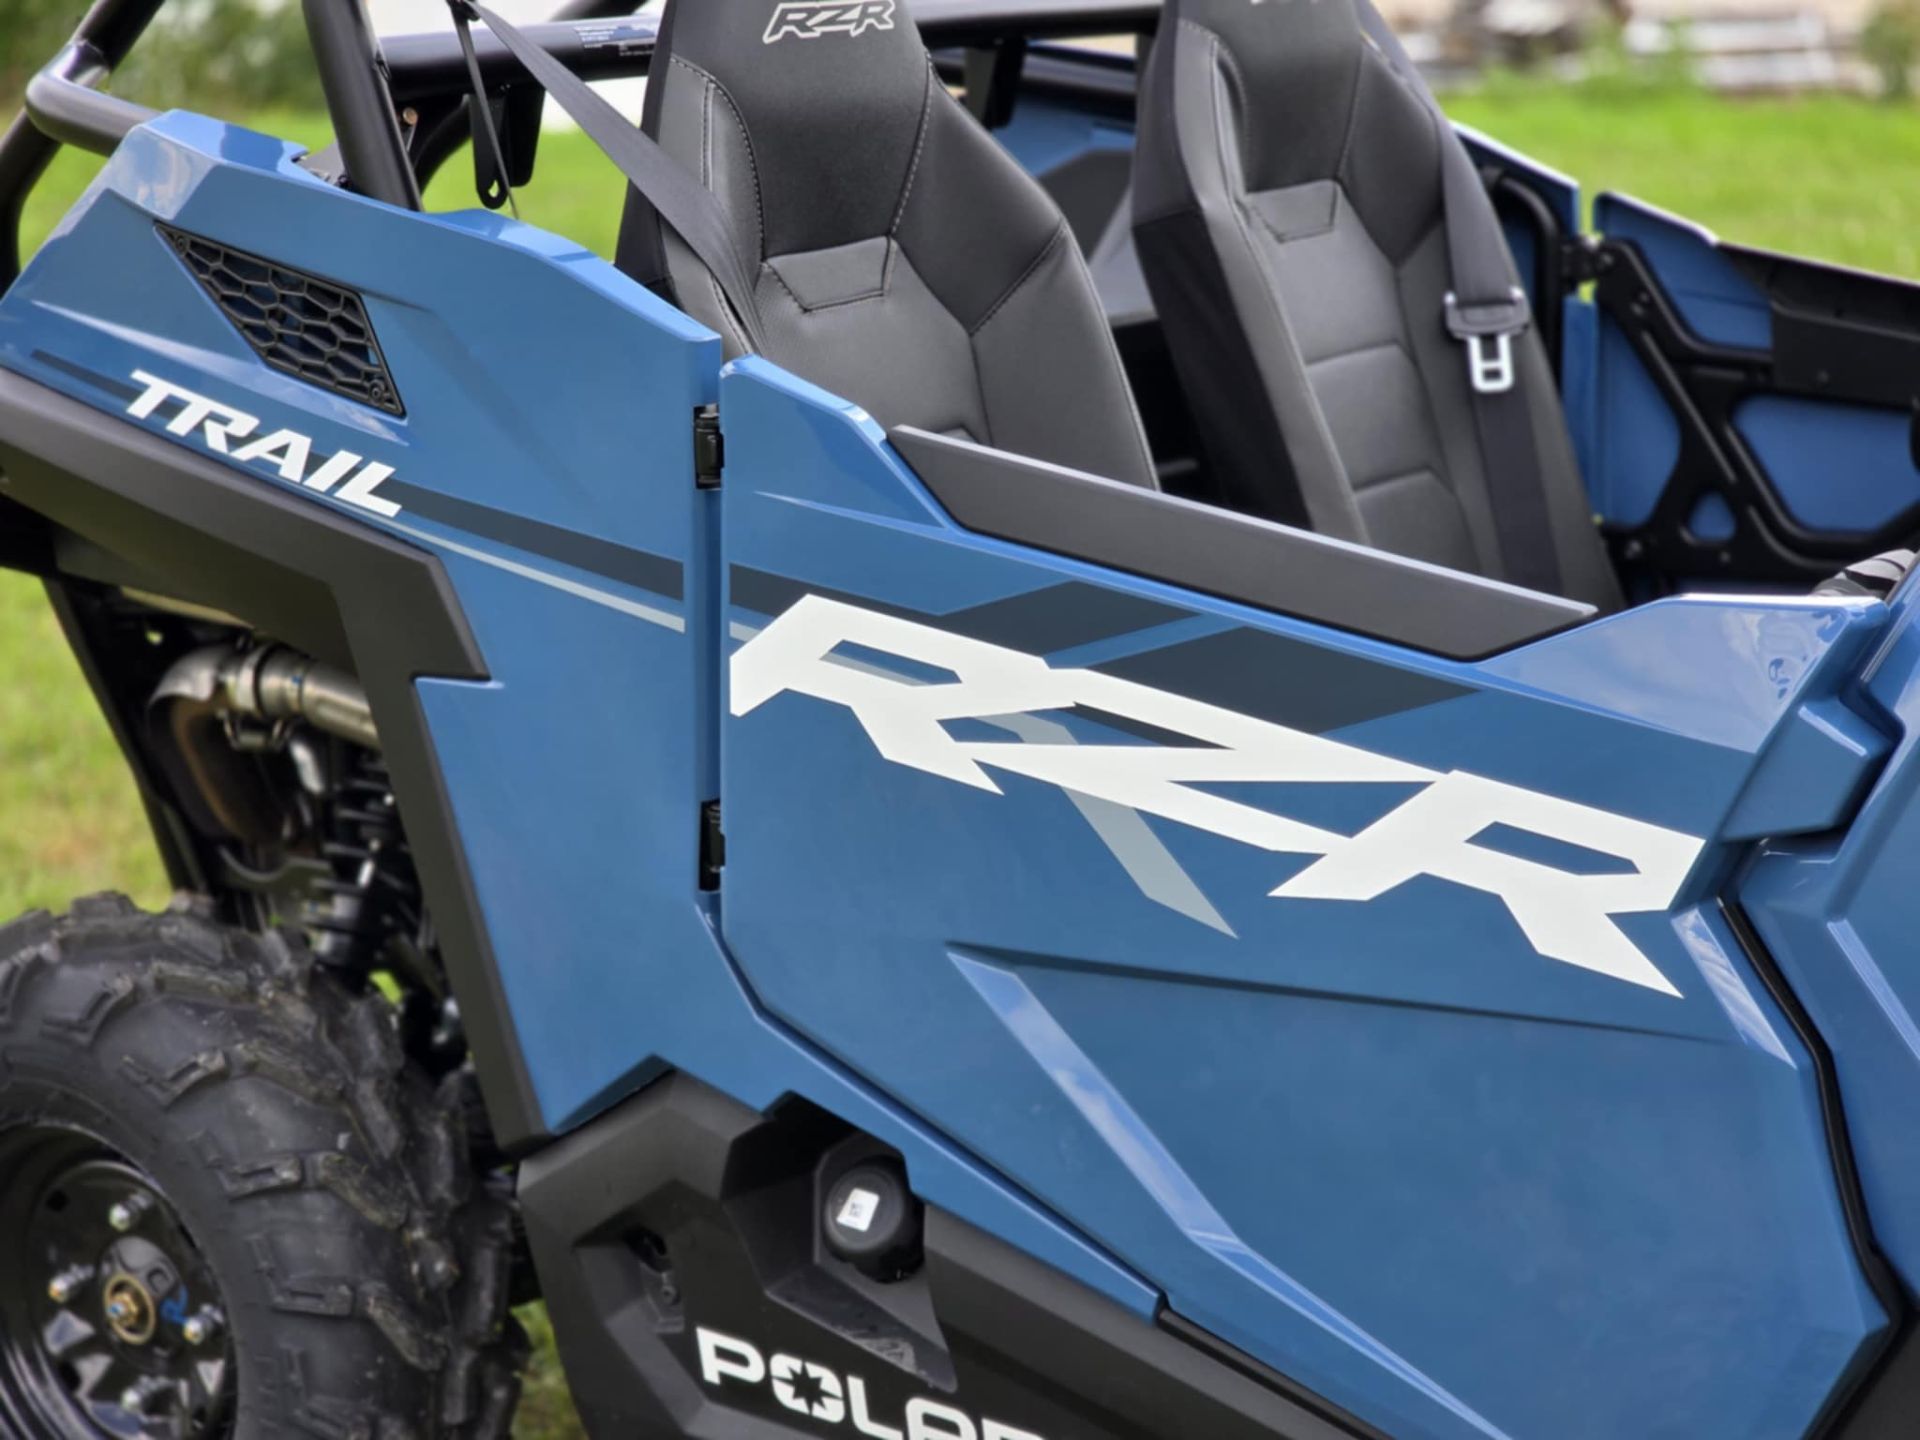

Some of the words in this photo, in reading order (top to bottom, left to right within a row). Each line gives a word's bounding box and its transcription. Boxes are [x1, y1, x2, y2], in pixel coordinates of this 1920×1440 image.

[763, 0, 895, 44] RZR
[126, 369, 402, 518] TRAIL
[730, 593, 1706, 999] RZR
